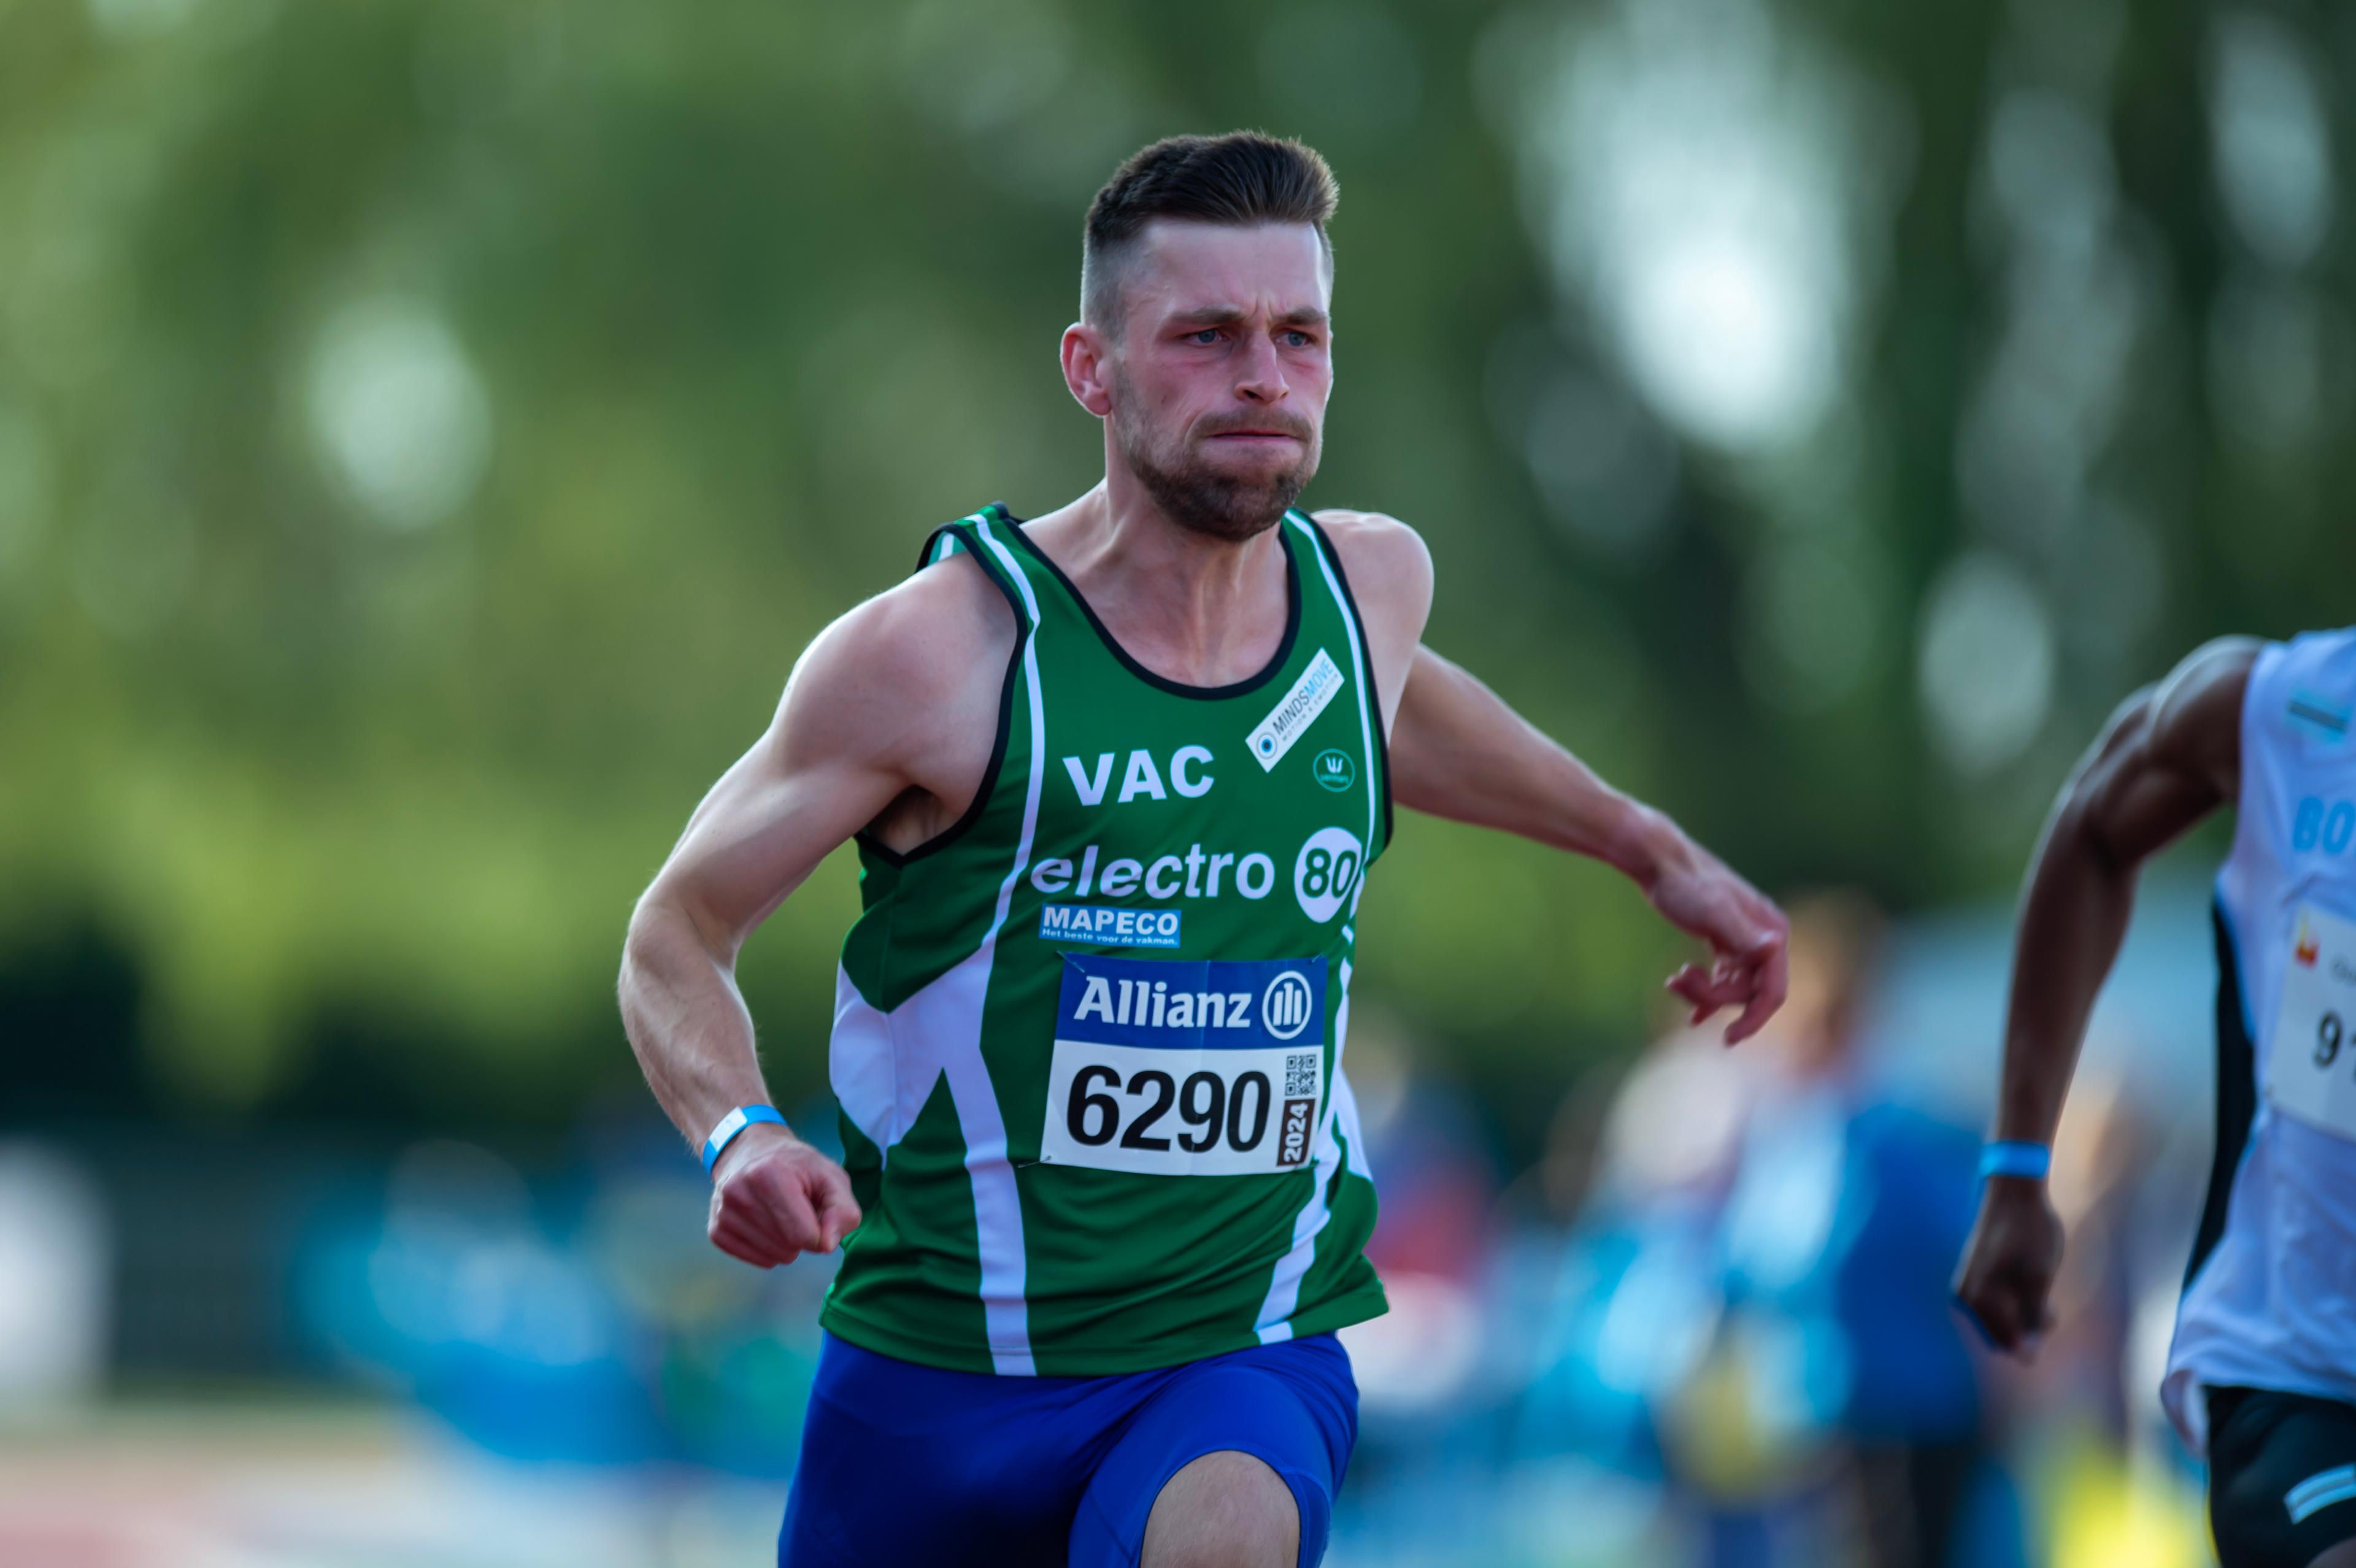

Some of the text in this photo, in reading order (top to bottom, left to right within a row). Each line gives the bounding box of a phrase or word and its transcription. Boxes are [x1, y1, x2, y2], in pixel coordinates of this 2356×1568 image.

[1272, 658, 1333, 735] MINDSMOVE
[1062, 745, 1214, 806] VAC
[1031, 844, 1358, 899] electro 80
[1042, 928, 1177, 945] Het beste voor de vakman.
[1044, 907, 1178, 936] MAPECO
[1074, 975, 1252, 1028] Allianz
[1066, 1064, 1271, 1153] 6290
[1284, 1102, 1307, 1162] 2024
